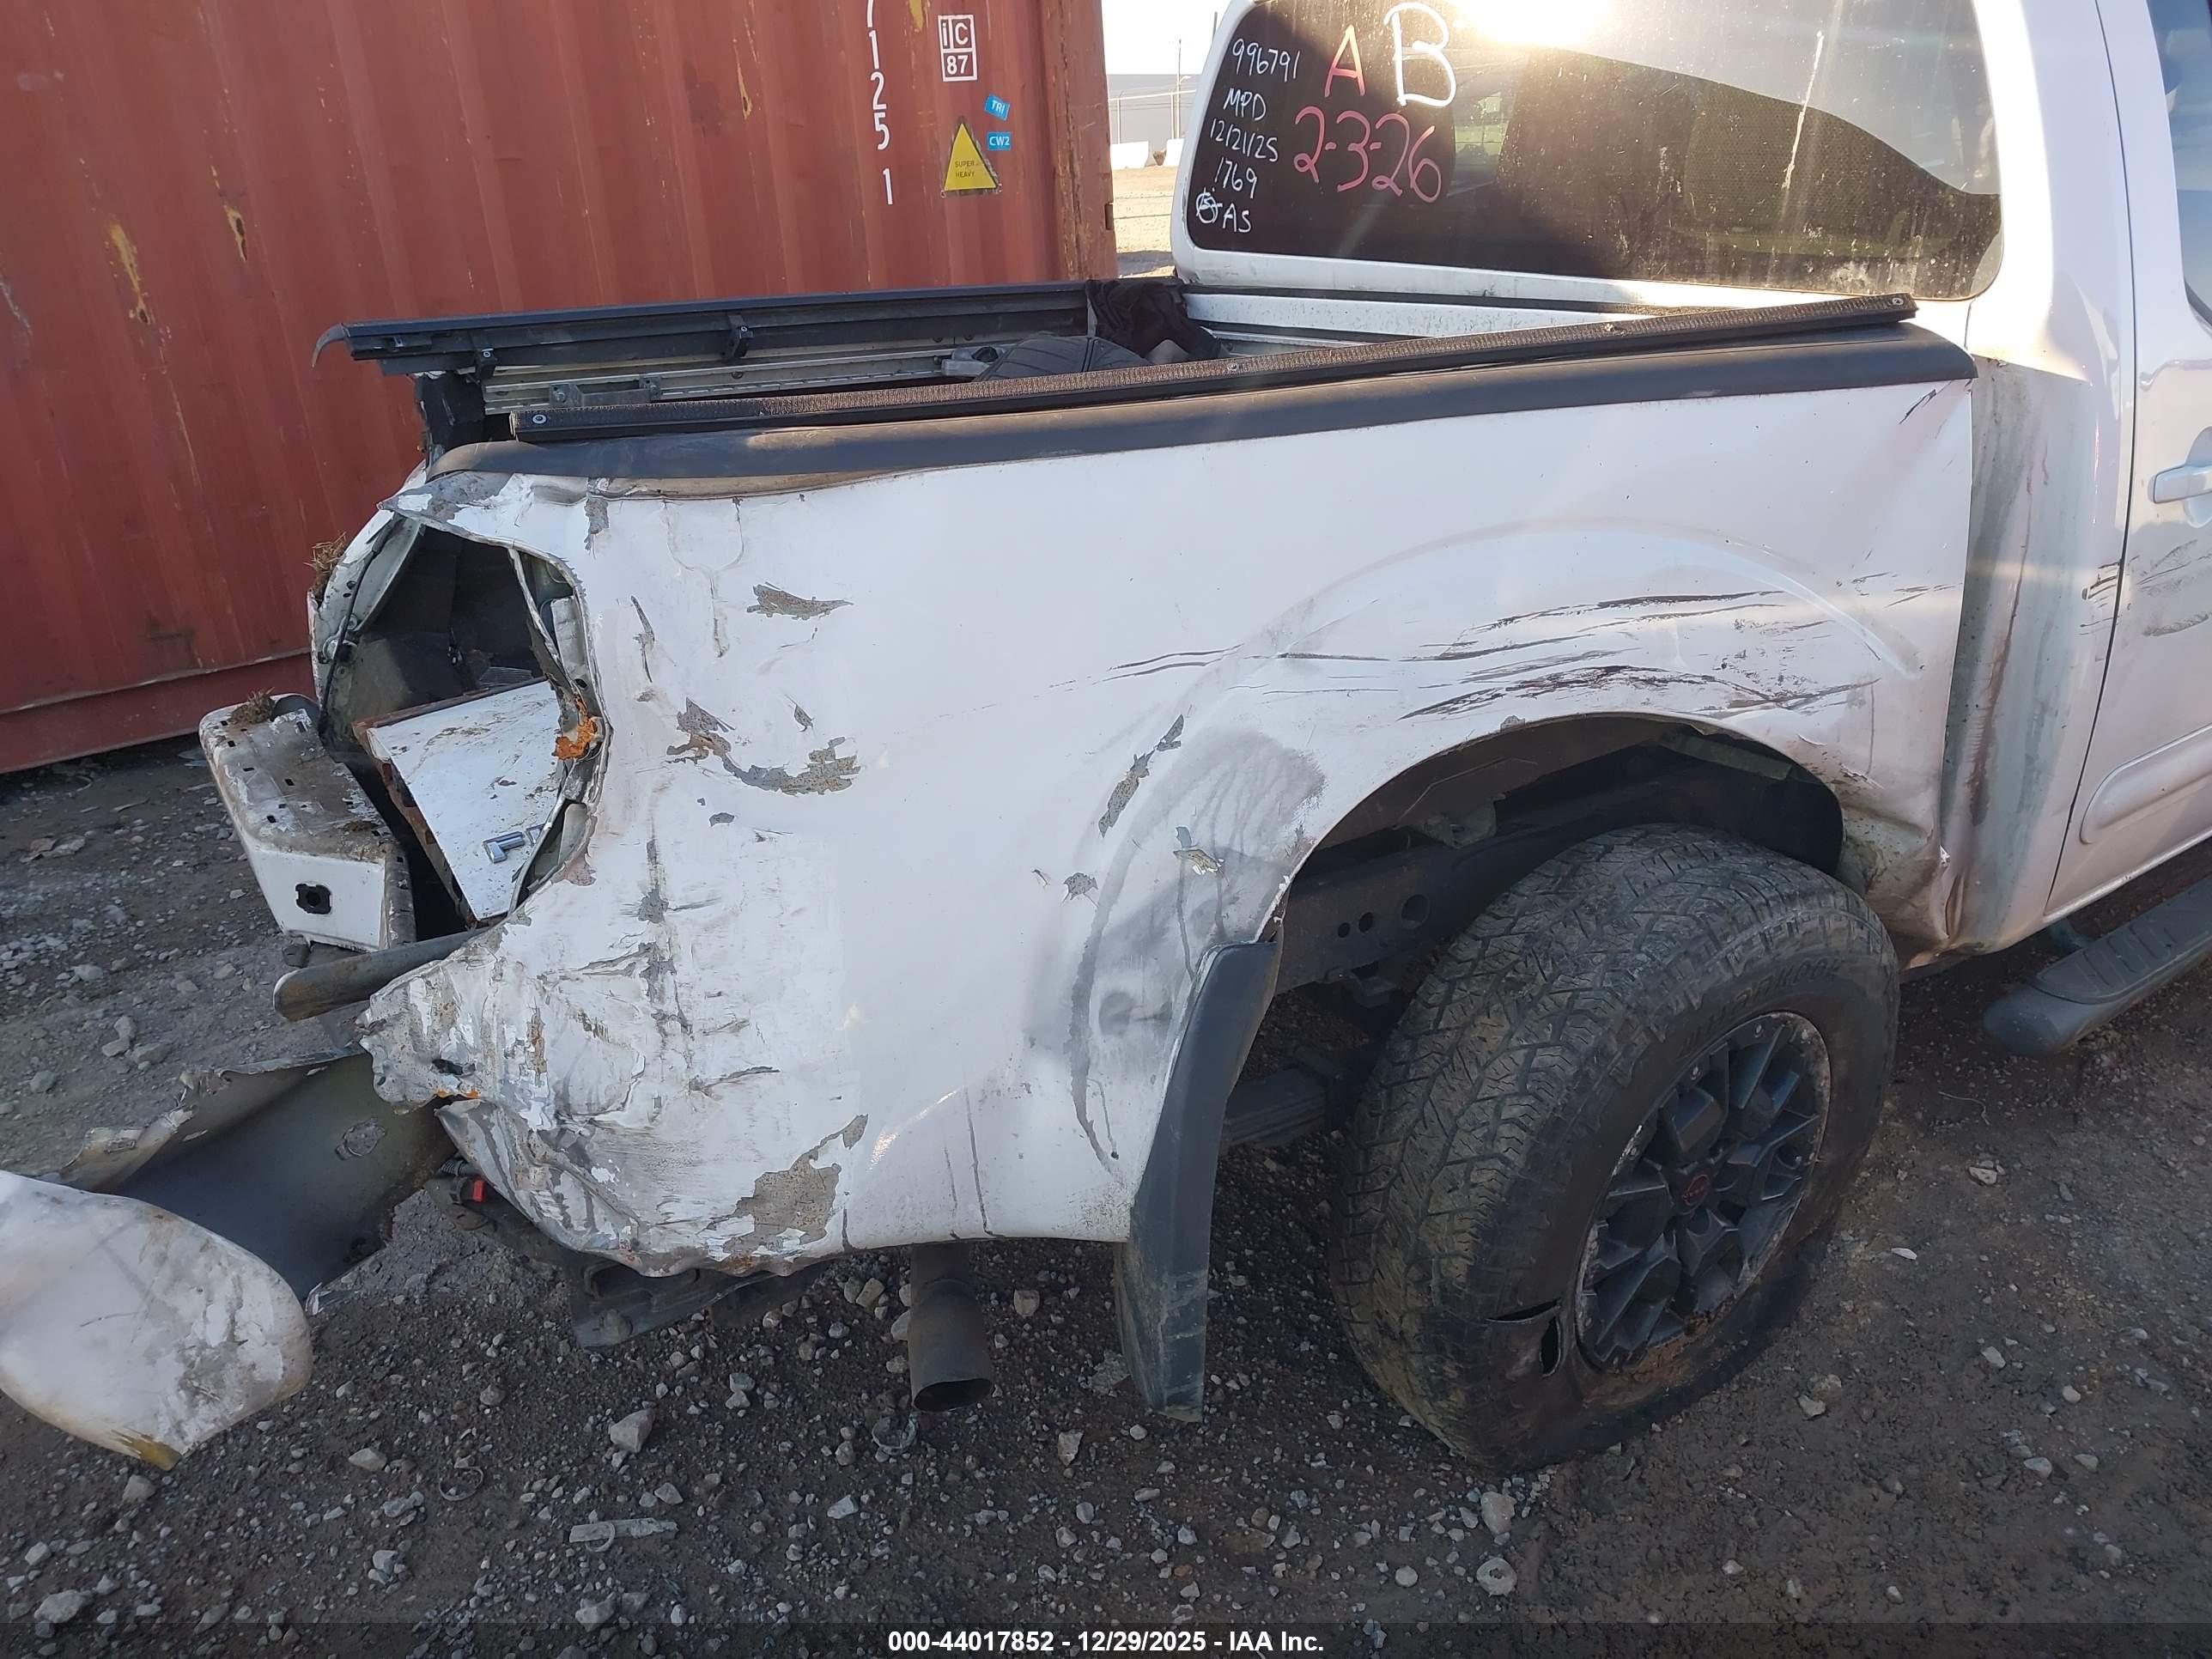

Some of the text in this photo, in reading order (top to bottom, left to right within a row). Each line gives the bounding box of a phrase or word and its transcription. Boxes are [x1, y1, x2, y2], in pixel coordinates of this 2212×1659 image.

[946, 55, 969, 75] 87
[1232, 38, 1301, 82] 996791
[1324, 24, 1365, 97] A
[1384, 2, 1457, 107] B
[992, 100, 1006, 114] TRI
[1223, 88, 1267, 121] MPD
[989, 136, 1011, 147] CW2
[1293, 106, 1443, 203] 2-3-26
[955, 160, 975, 168] SUPER
[1213, 157, 1258, 199] 1769
[1222, 203, 1252, 233] AS
